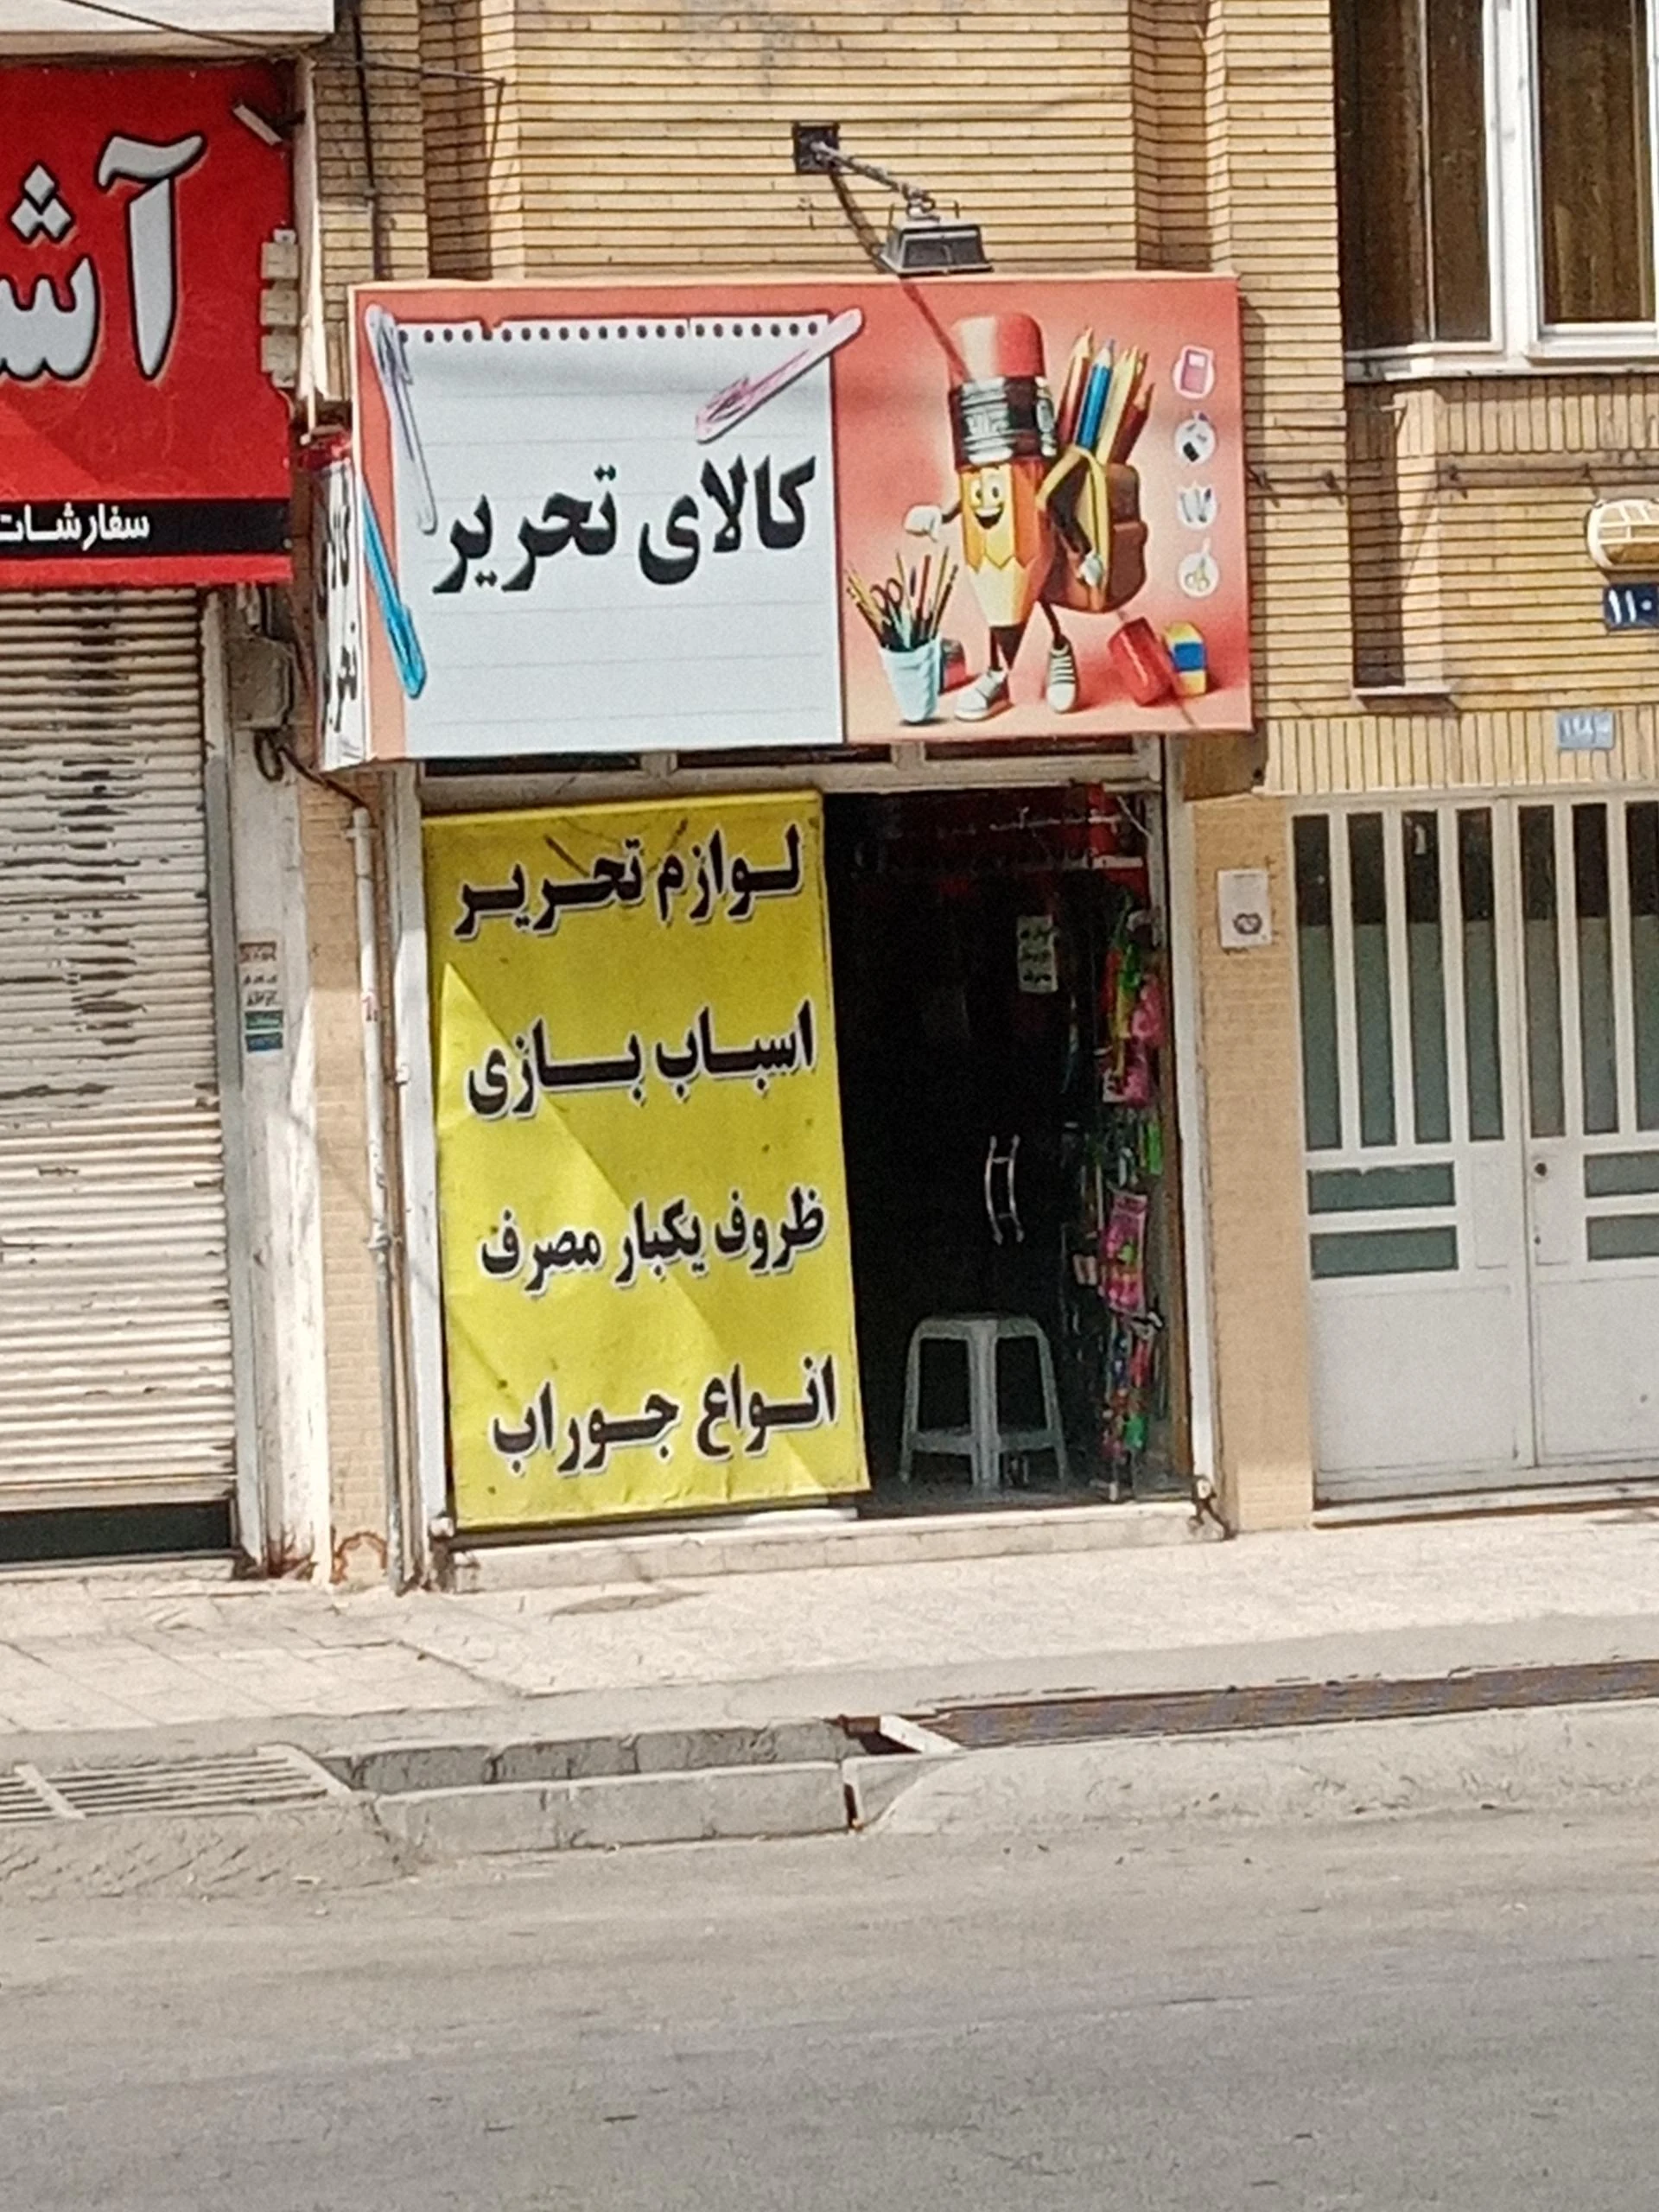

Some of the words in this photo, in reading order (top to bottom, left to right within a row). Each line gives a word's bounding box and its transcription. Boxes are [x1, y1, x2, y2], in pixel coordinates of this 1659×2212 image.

[432, 464, 617, 594] تحریر
[639, 454, 817, 586] کالای
[454, 837, 645, 937] تحریر
[657, 823, 802, 923] لوازم
[467, 1017, 643, 1117] بازی
[656, 998, 815, 1097] اسباب
[480, 1210, 602, 1293] مصرف
[614, 1198, 705, 1283] یکبار
[714, 1185, 826, 1270] ظروف
[493, 1381, 680, 1473] جوراب
[696, 1354, 837, 1458] انواع
